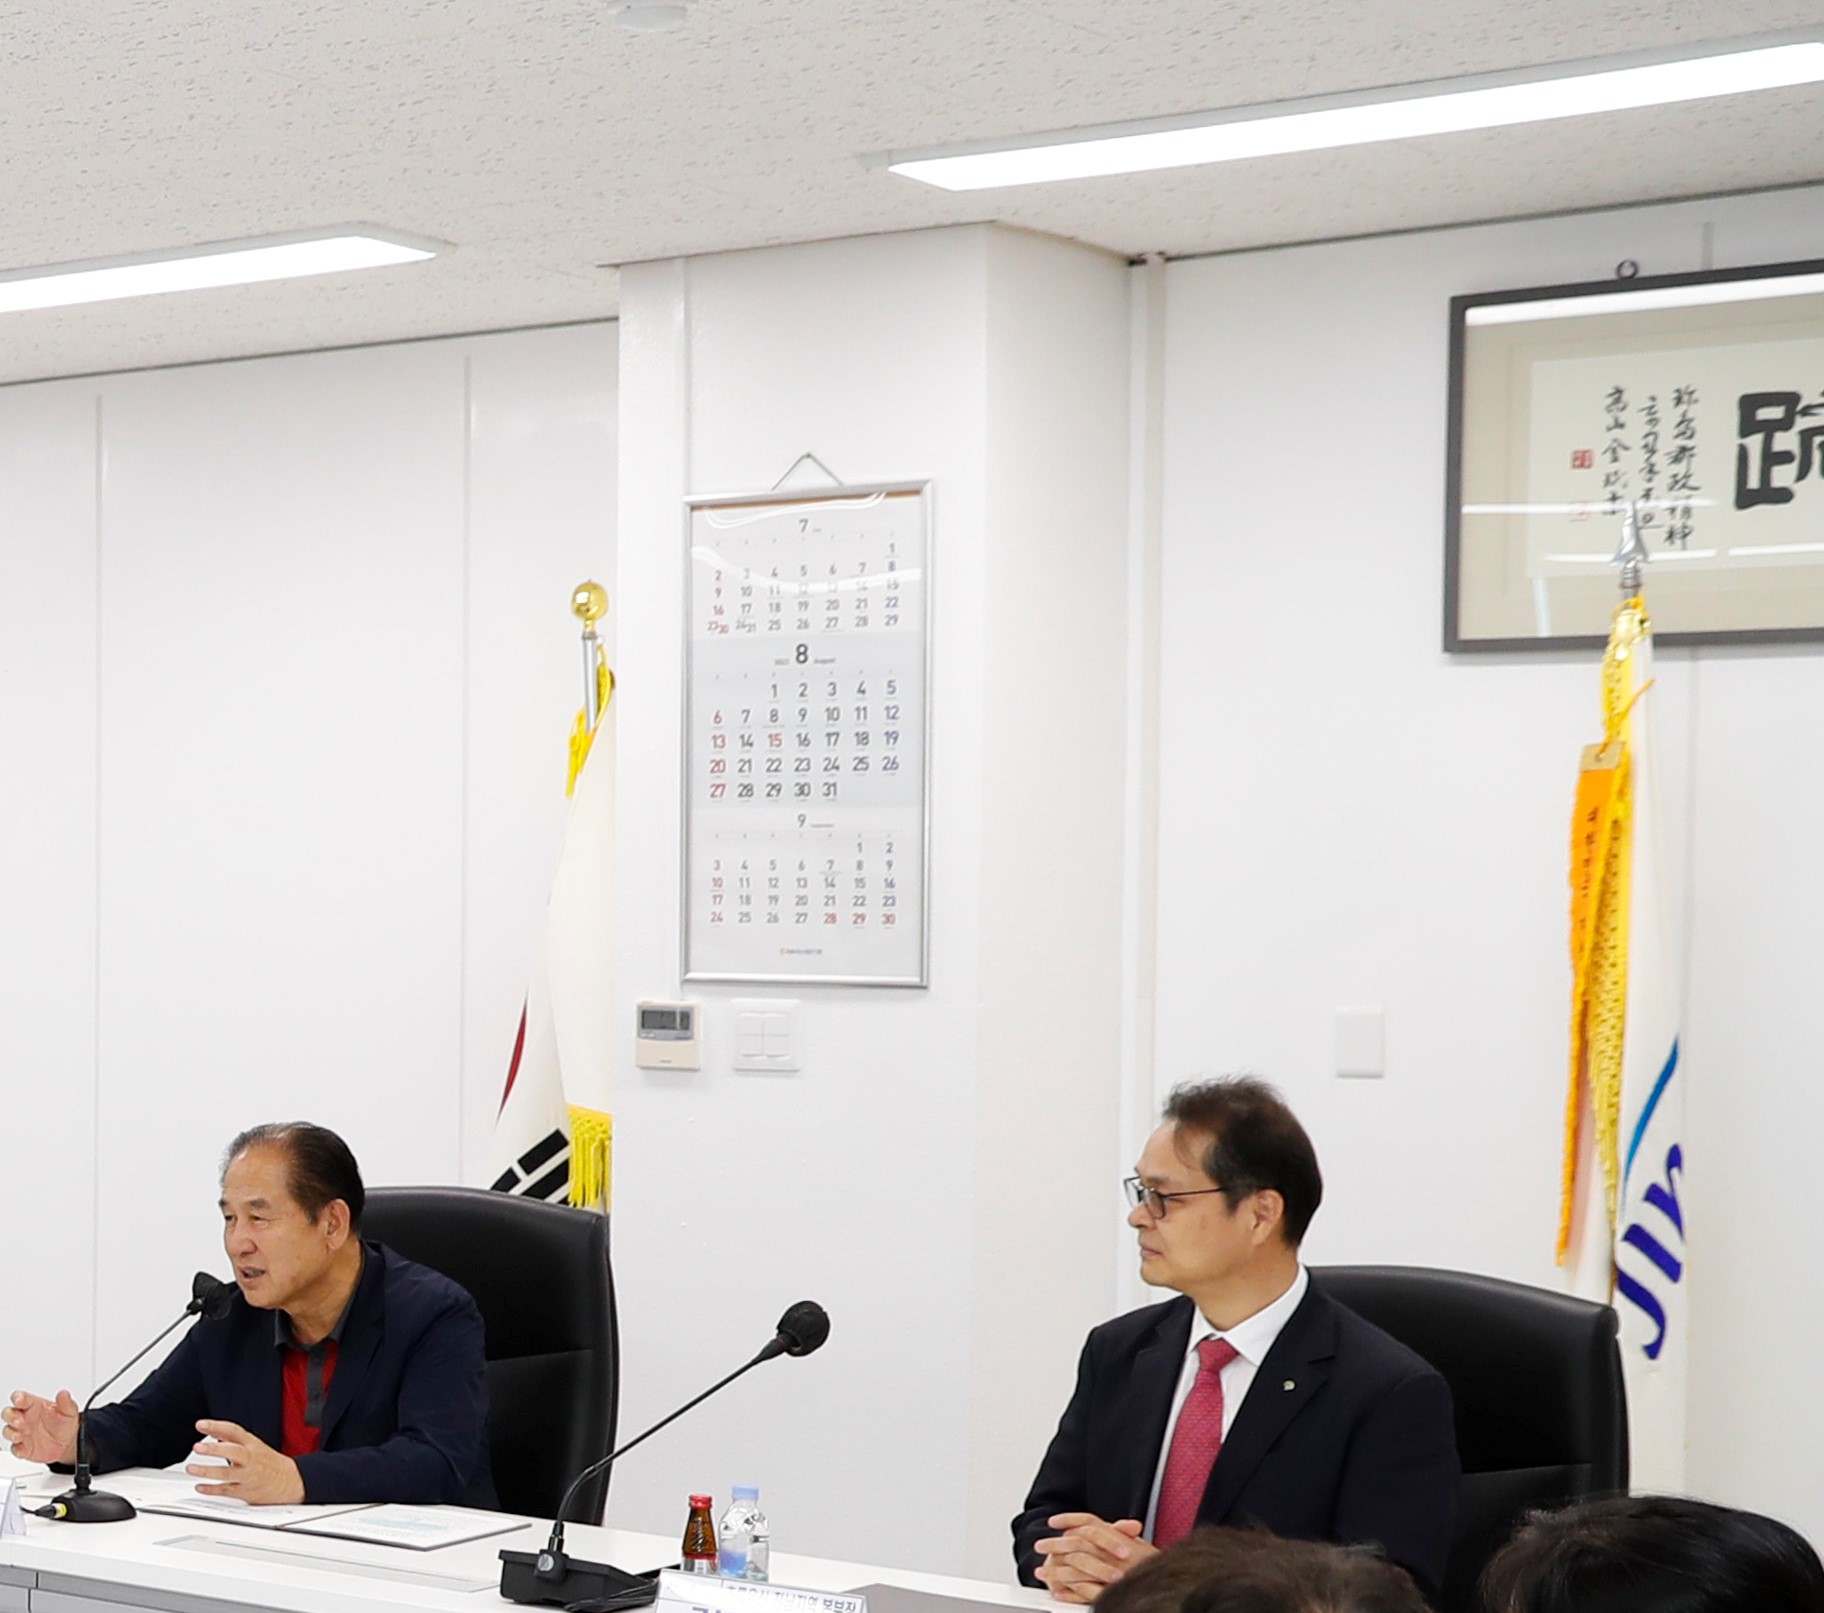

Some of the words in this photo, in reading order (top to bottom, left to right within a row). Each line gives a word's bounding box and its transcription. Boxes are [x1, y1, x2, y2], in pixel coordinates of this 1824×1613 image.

[799, 519, 808, 533] 7
[795, 643, 808, 664] 8
[771, 684, 778, 698] 1
[798, 683, 807, 697] 2
[828, 682, 837, 697] 3
[857, 681, 866, 695] 4
[887, 680, 896, 695] 5
[713, 710, 722, 725] 6
[741, 709, 750, 724] 7
[769, 708, 779, 723] 8
[798, 707, 807, 722] 9
[824, 707, 840, 722] 10
[855, 706, 868, 721] 11
[884, 705, 900, 720] 12
[711, 735, 726, 749] 13
[739, 734, 754, 748] 14
[768, 733, 782, 748] 15
[796, 732, 811, 747] 16
[825, 732, 840, 746] 17
[854, 731, 870, 746] 18
[884, 731, 900, 745] 19
[710, 759, 726, 774] 20
[737, 759, 752, 773] 21
[765, 758, 782, 773] 22
[794, 758, 811, 772] 23
[823, 757, 840, 772] 24
[852, 756, 870, 771] 25
[882, 756, 900, 771] 26
[710, 783, 726, 798] 27
[737, 783, 754, 798] 28
[765, 783, 782, 797] 29
[794, 782, 811, 797] 30
[822, 782, 837, 797] 31
[797, 813, 806, 828] 9
[857, 842, 863, 853] 1
[886, 842, 893, 853] 2
